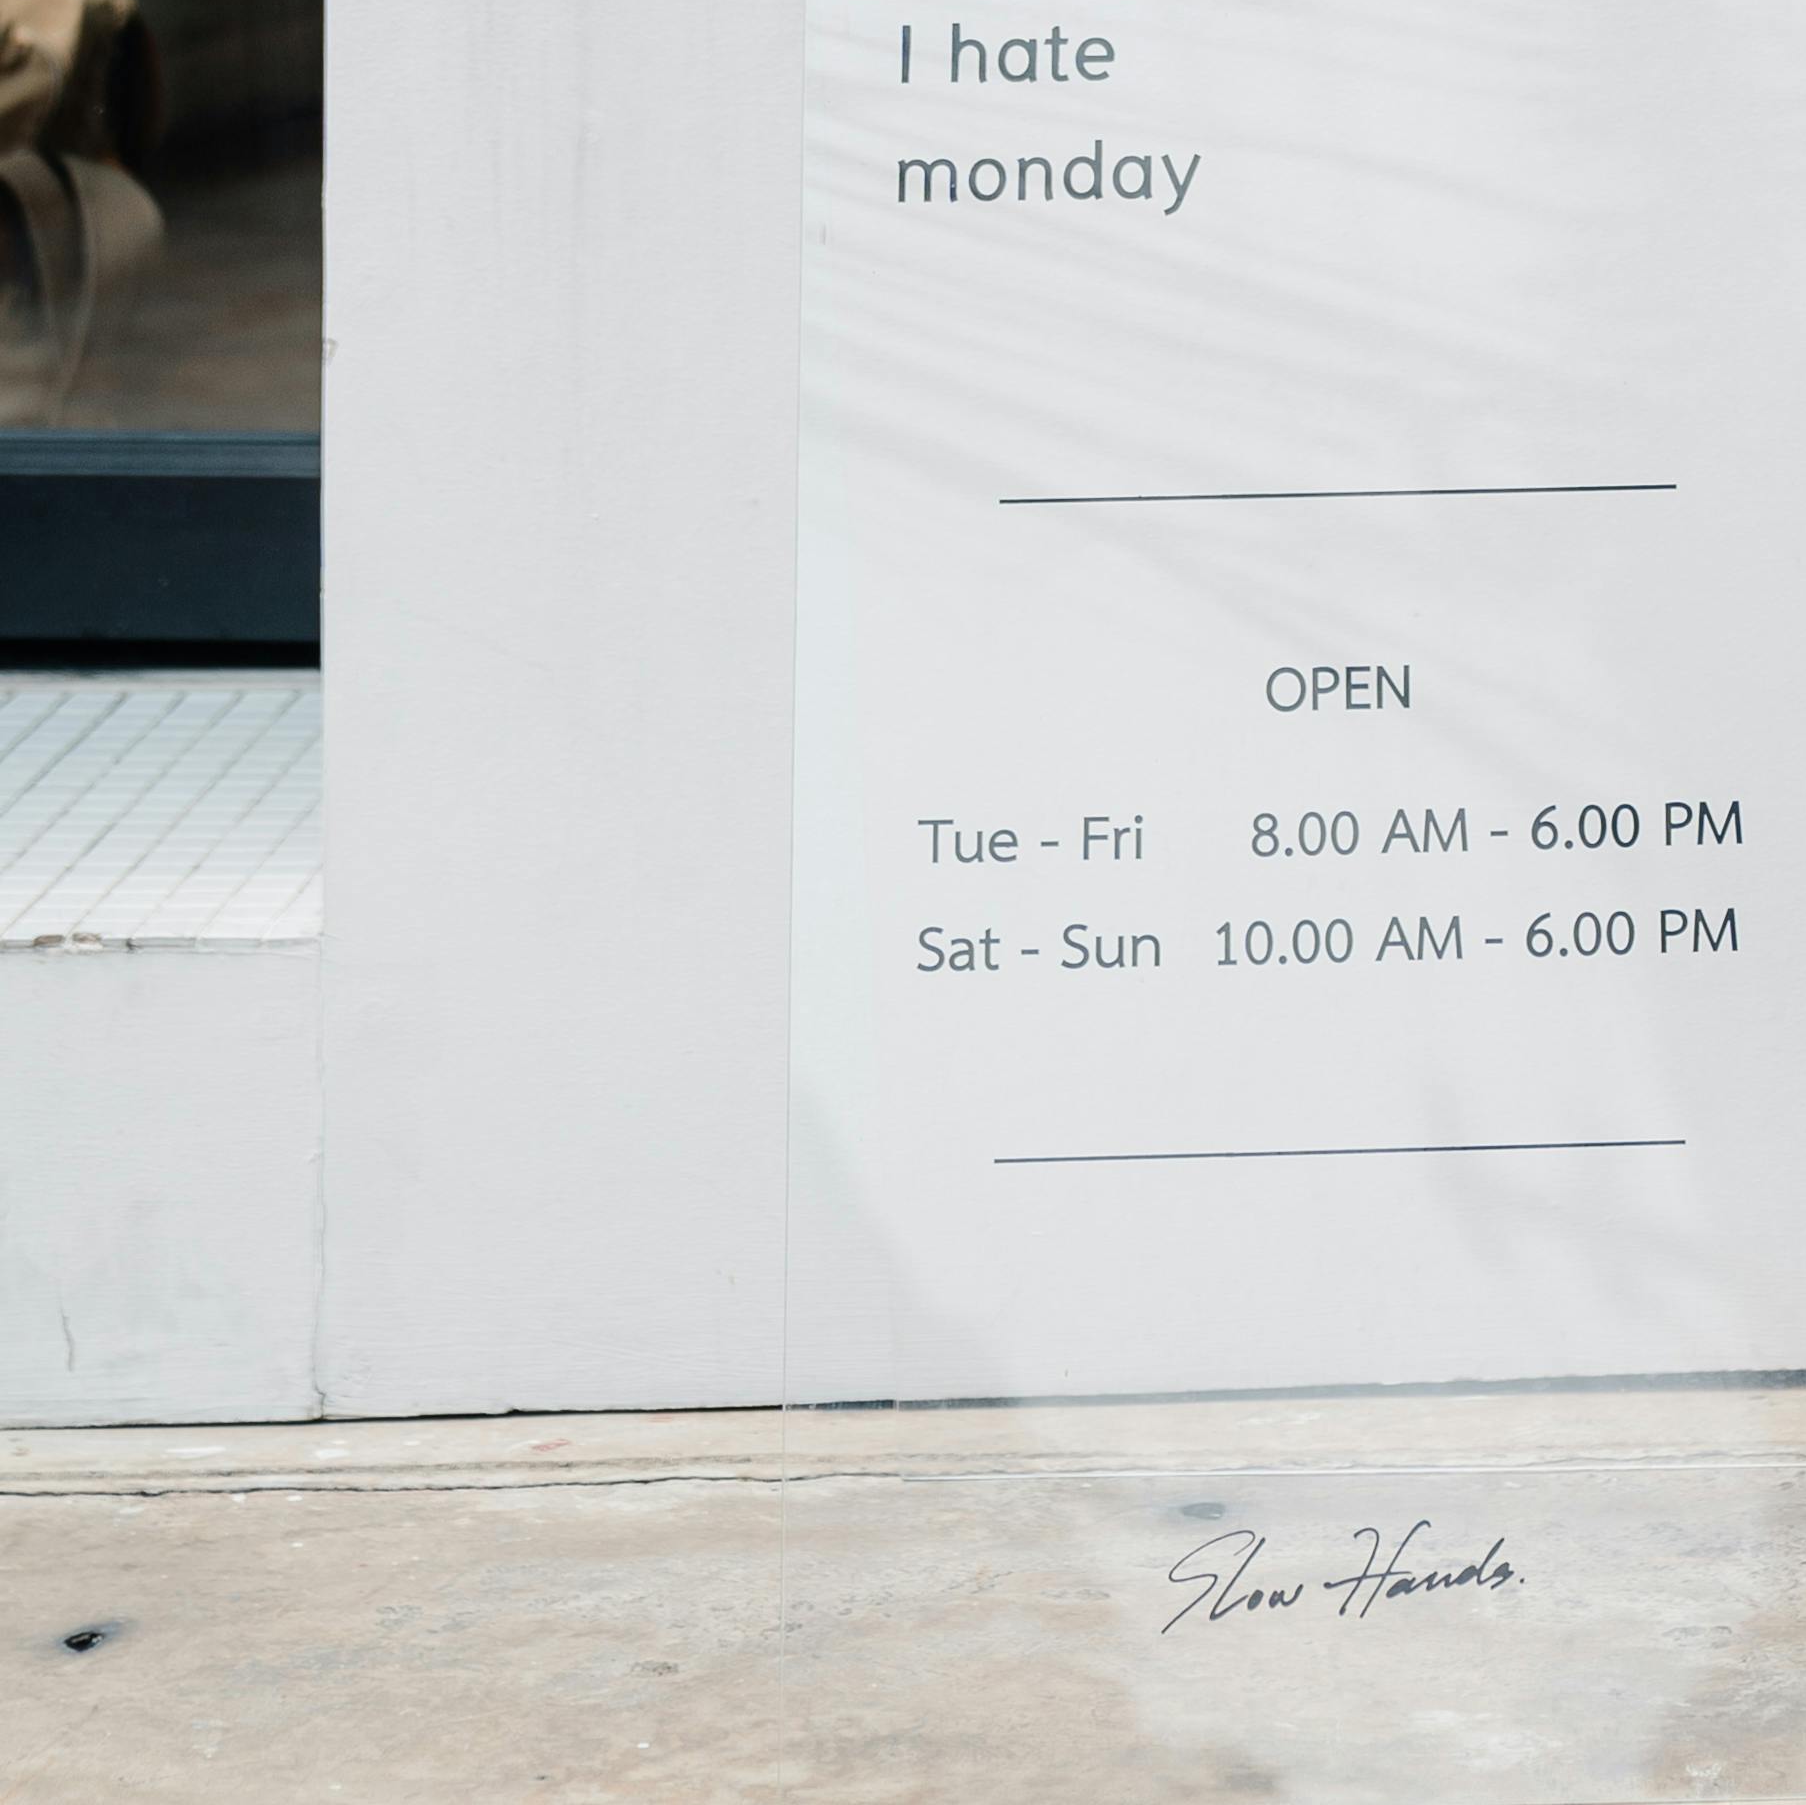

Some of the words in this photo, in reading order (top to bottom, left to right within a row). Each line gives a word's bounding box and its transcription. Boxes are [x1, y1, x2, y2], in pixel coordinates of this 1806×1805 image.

[900, 24, 912, 84] I
[950, 22, 1116, 84] hate
[897, 139, 1202, 217] monday
[1265, 664, 1411, 713] OPEN
[917, 819, 1019, 864] Tue
[1082, 814, 1144, 861] Fri
[1251, 810, 1360, 858] 8.00
[1380, 807, 1469, 854] AM
[1530, 803, 1641, 851] 6.00
[1664, 800, 1743, 847] PM
[916, 926, 1001, 973] Sat
[1060, 923, 1161, 970] Sun
[1215, 918, 1354, 966] 10.00
[1375, 915, 1464, 962] AM
[1525, 910, 1636, 958] 6.00
[1659, 907, 1739, 954] PM
[1161, 1529, 1304, 1634] Slow
